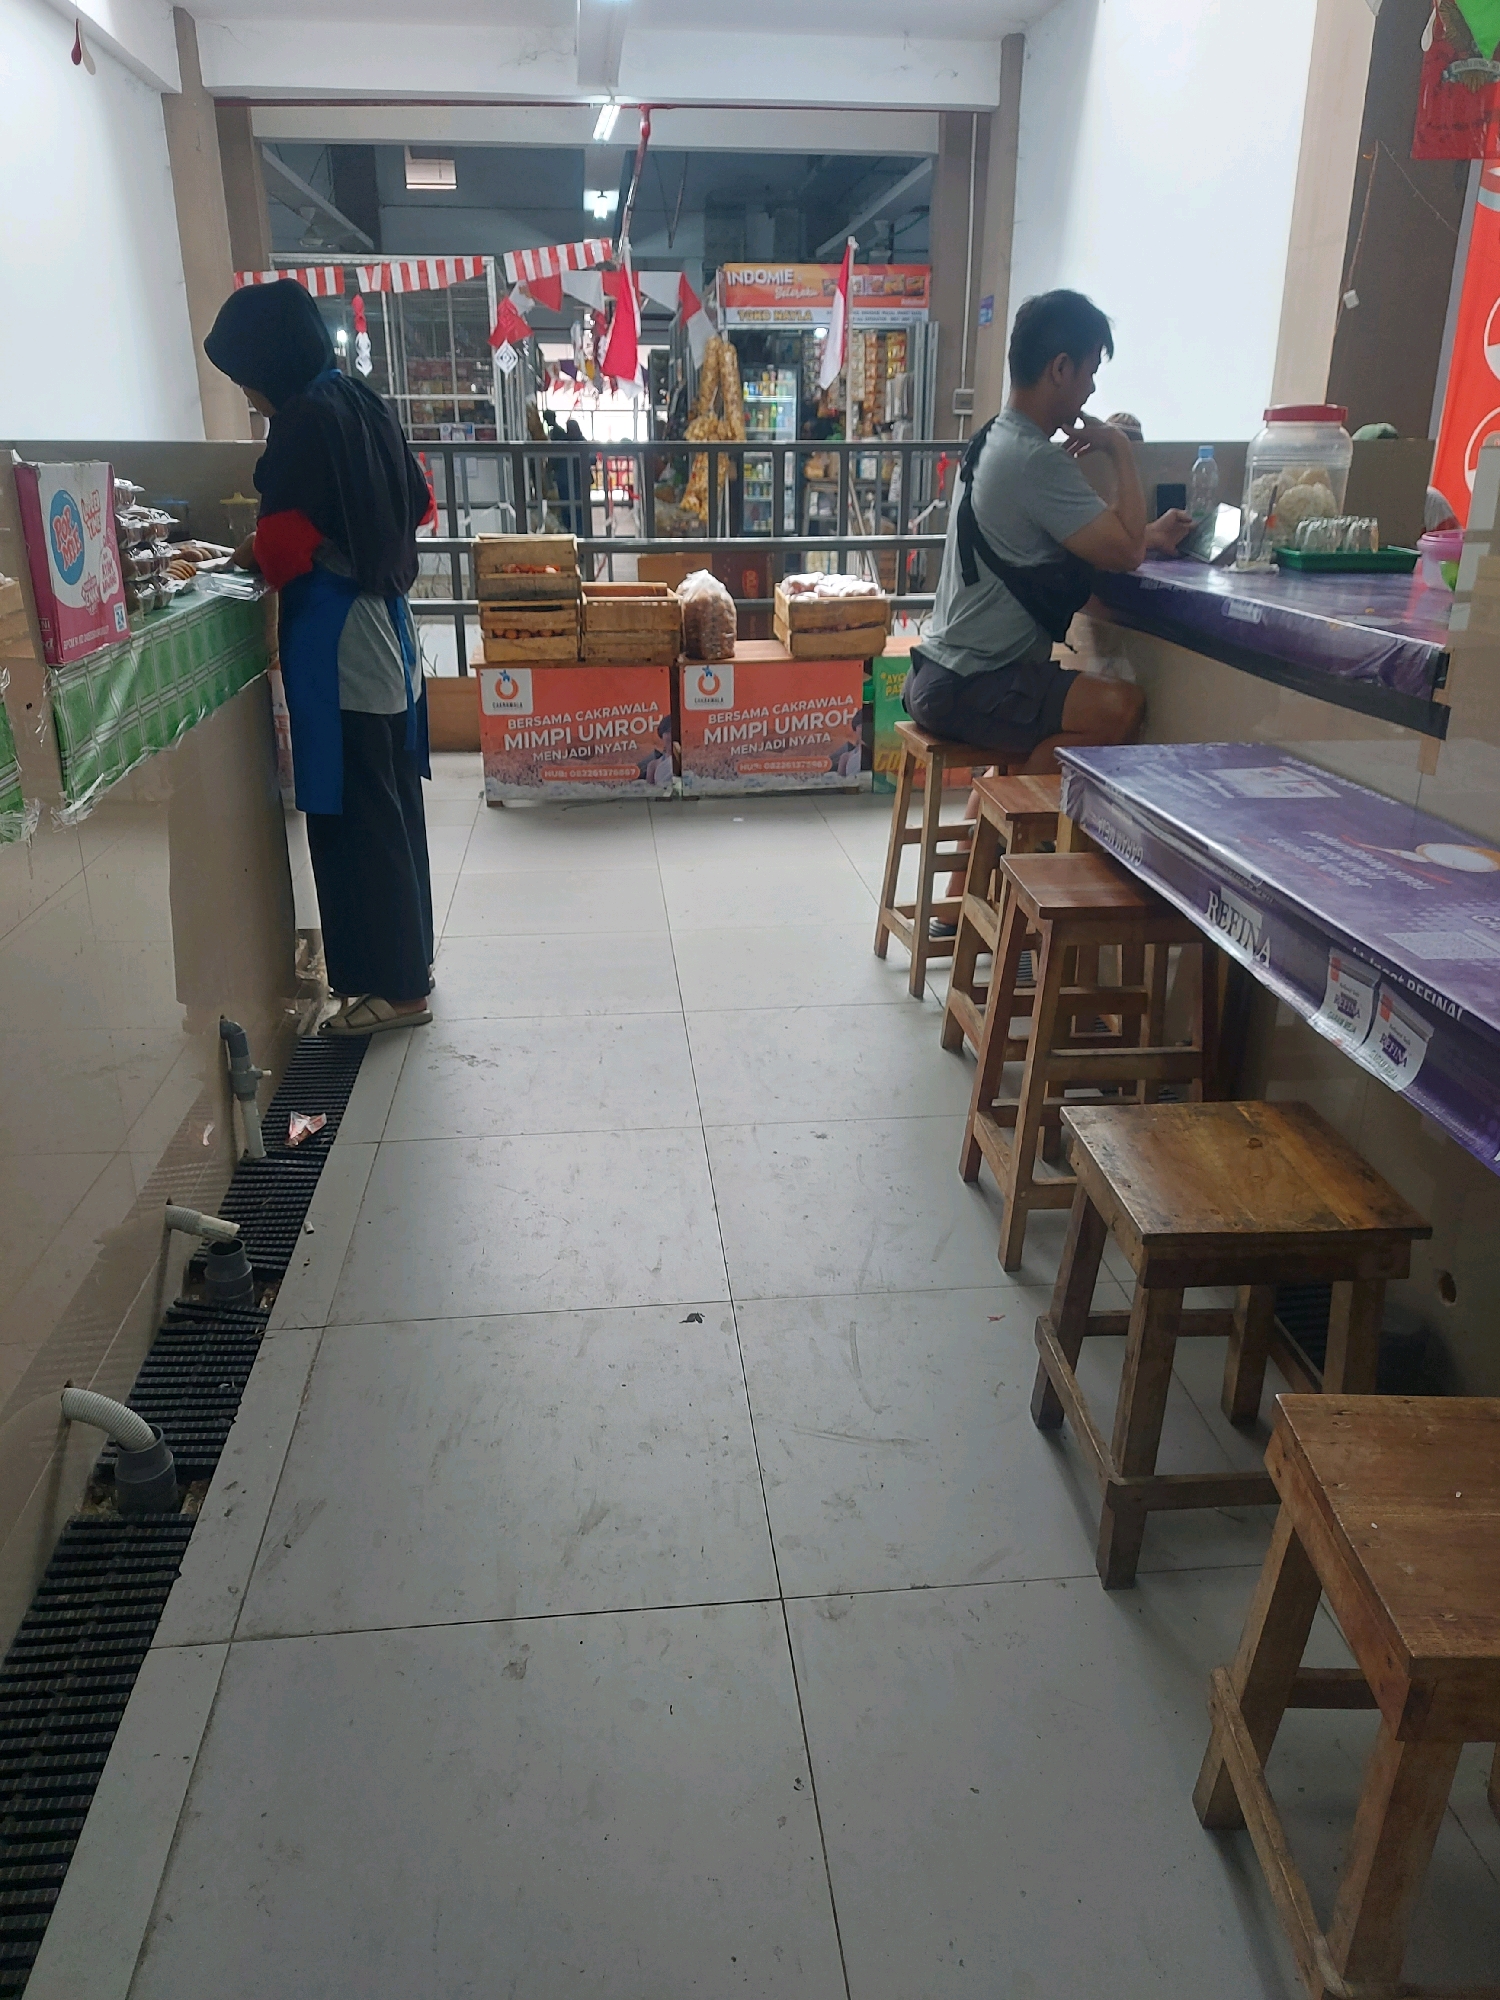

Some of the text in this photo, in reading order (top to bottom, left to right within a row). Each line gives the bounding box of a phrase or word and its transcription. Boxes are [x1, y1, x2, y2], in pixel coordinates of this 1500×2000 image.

[727, 268, 794, 287] INDOMIE
[53, 505, 72, 552] POP
[62, 522, 83, 571] MIE
[508, 701, 659, 730] BERSAMA CAKRAWALA
[708, 694, 854, 725] BERSAMA CAKRAWALA
[503, 714, 665, 751] MIMPI UMROH
[703, 707, 860, 746] MIMPI UMROH
[533, 739, 638, 762] MENJADI NYATA
[730, 731, 832, 757] MENJADI NYATA
[1205, 890, 1271, 968] REFINA
[1333, 993, 1361, 1018] REFINA
[1379, 1032, 1408, 1067] REFINA
